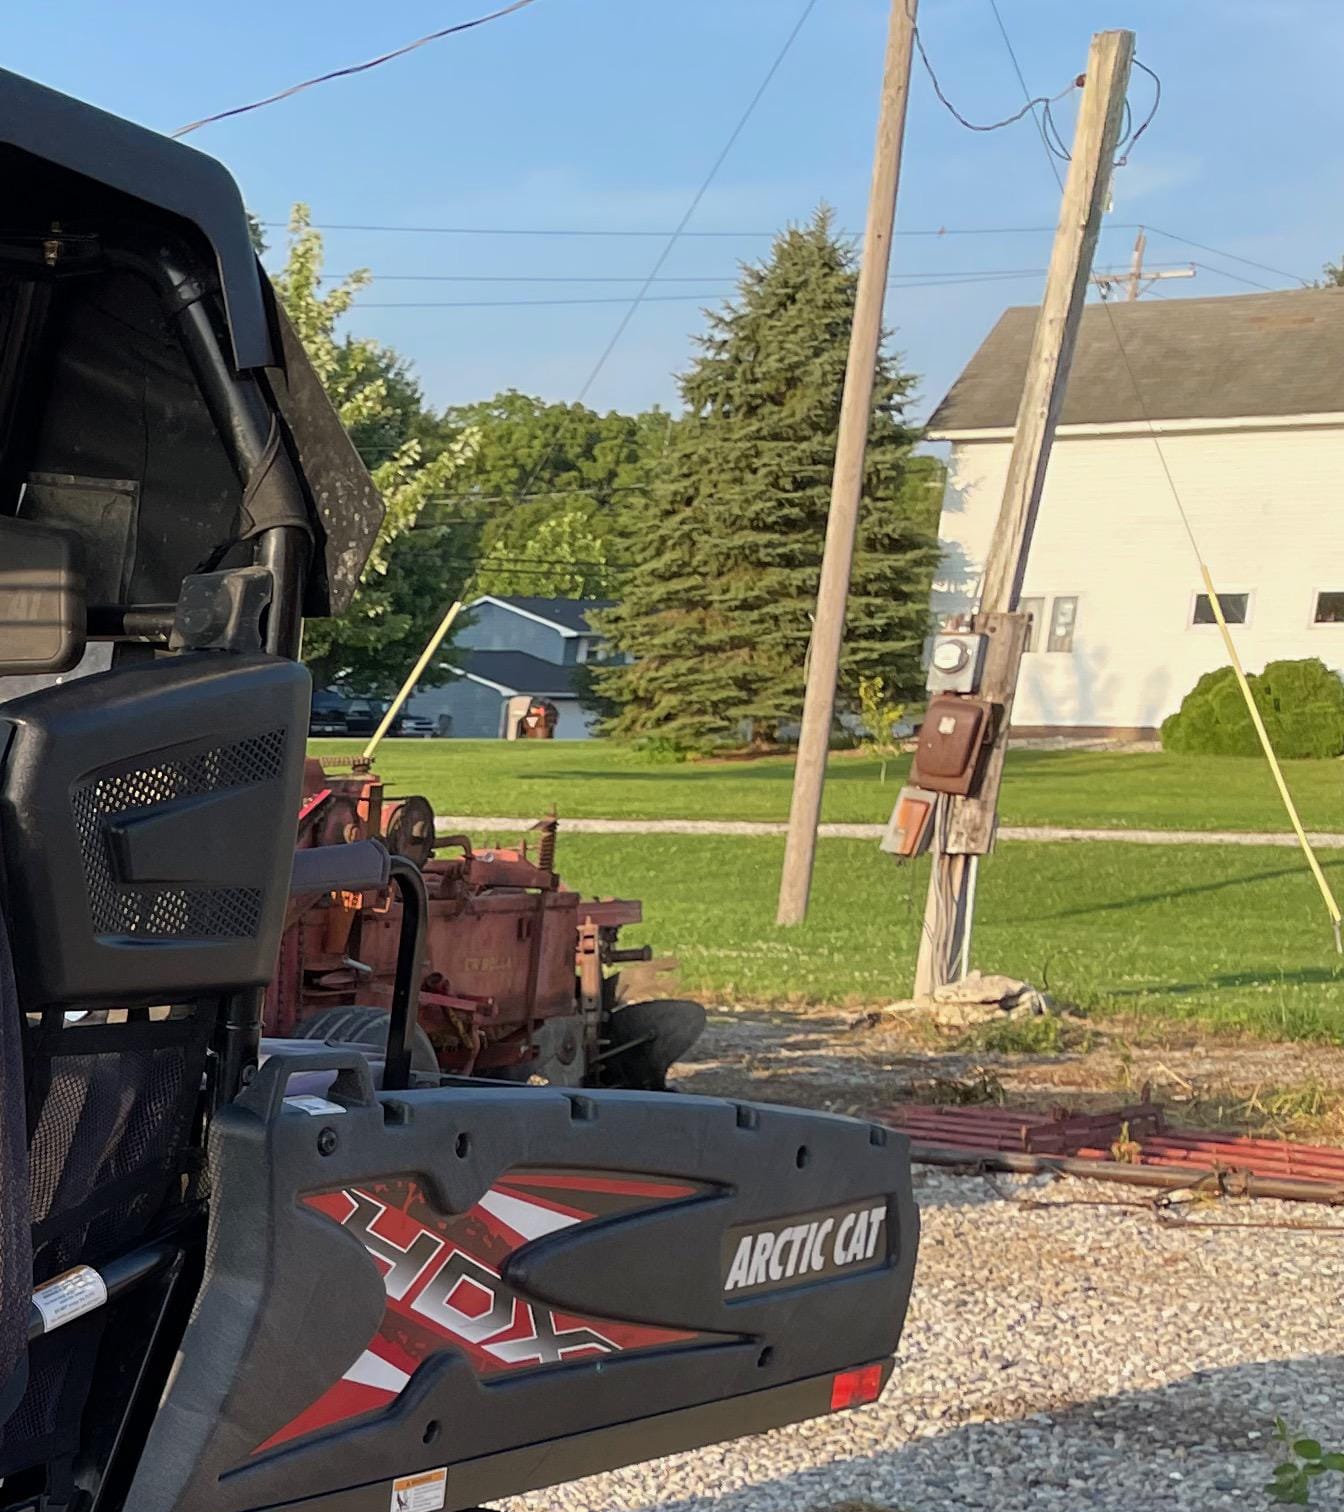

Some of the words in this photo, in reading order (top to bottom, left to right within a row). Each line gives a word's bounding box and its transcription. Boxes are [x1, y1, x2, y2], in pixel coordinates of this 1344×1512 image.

[340, 1187, 623, 1364] HDX
[724, 1218, 832, 1290] ARCTIC
[832, 1206, 887, 1265] CAT
